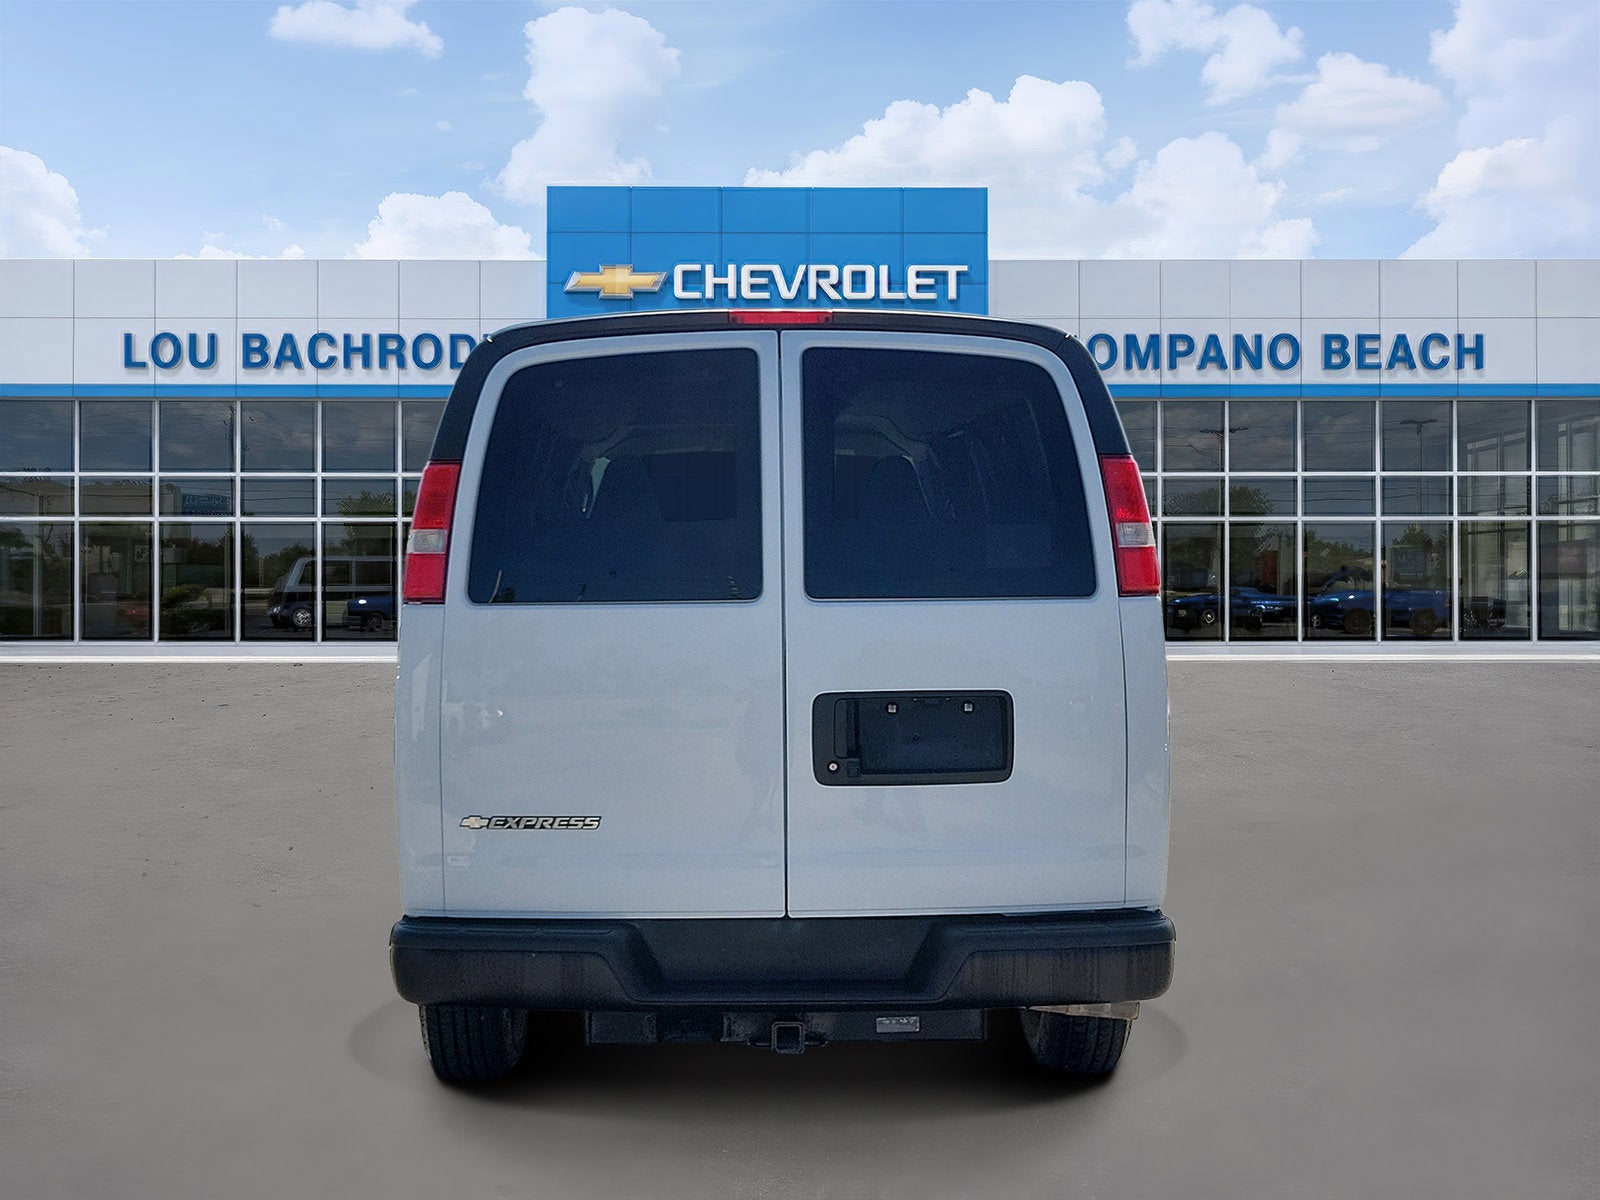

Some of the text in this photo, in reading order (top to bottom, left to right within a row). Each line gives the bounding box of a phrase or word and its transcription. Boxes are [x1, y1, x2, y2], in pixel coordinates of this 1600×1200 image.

[673, 264, 968, 300] CHEVROLET
[123, 332, 218, 370] LOU
[242, 332, 491, 370] BACHROD
[1321, 332, 1484, 371] BEACH
[487, 816, 601, 829] EXPRESS
